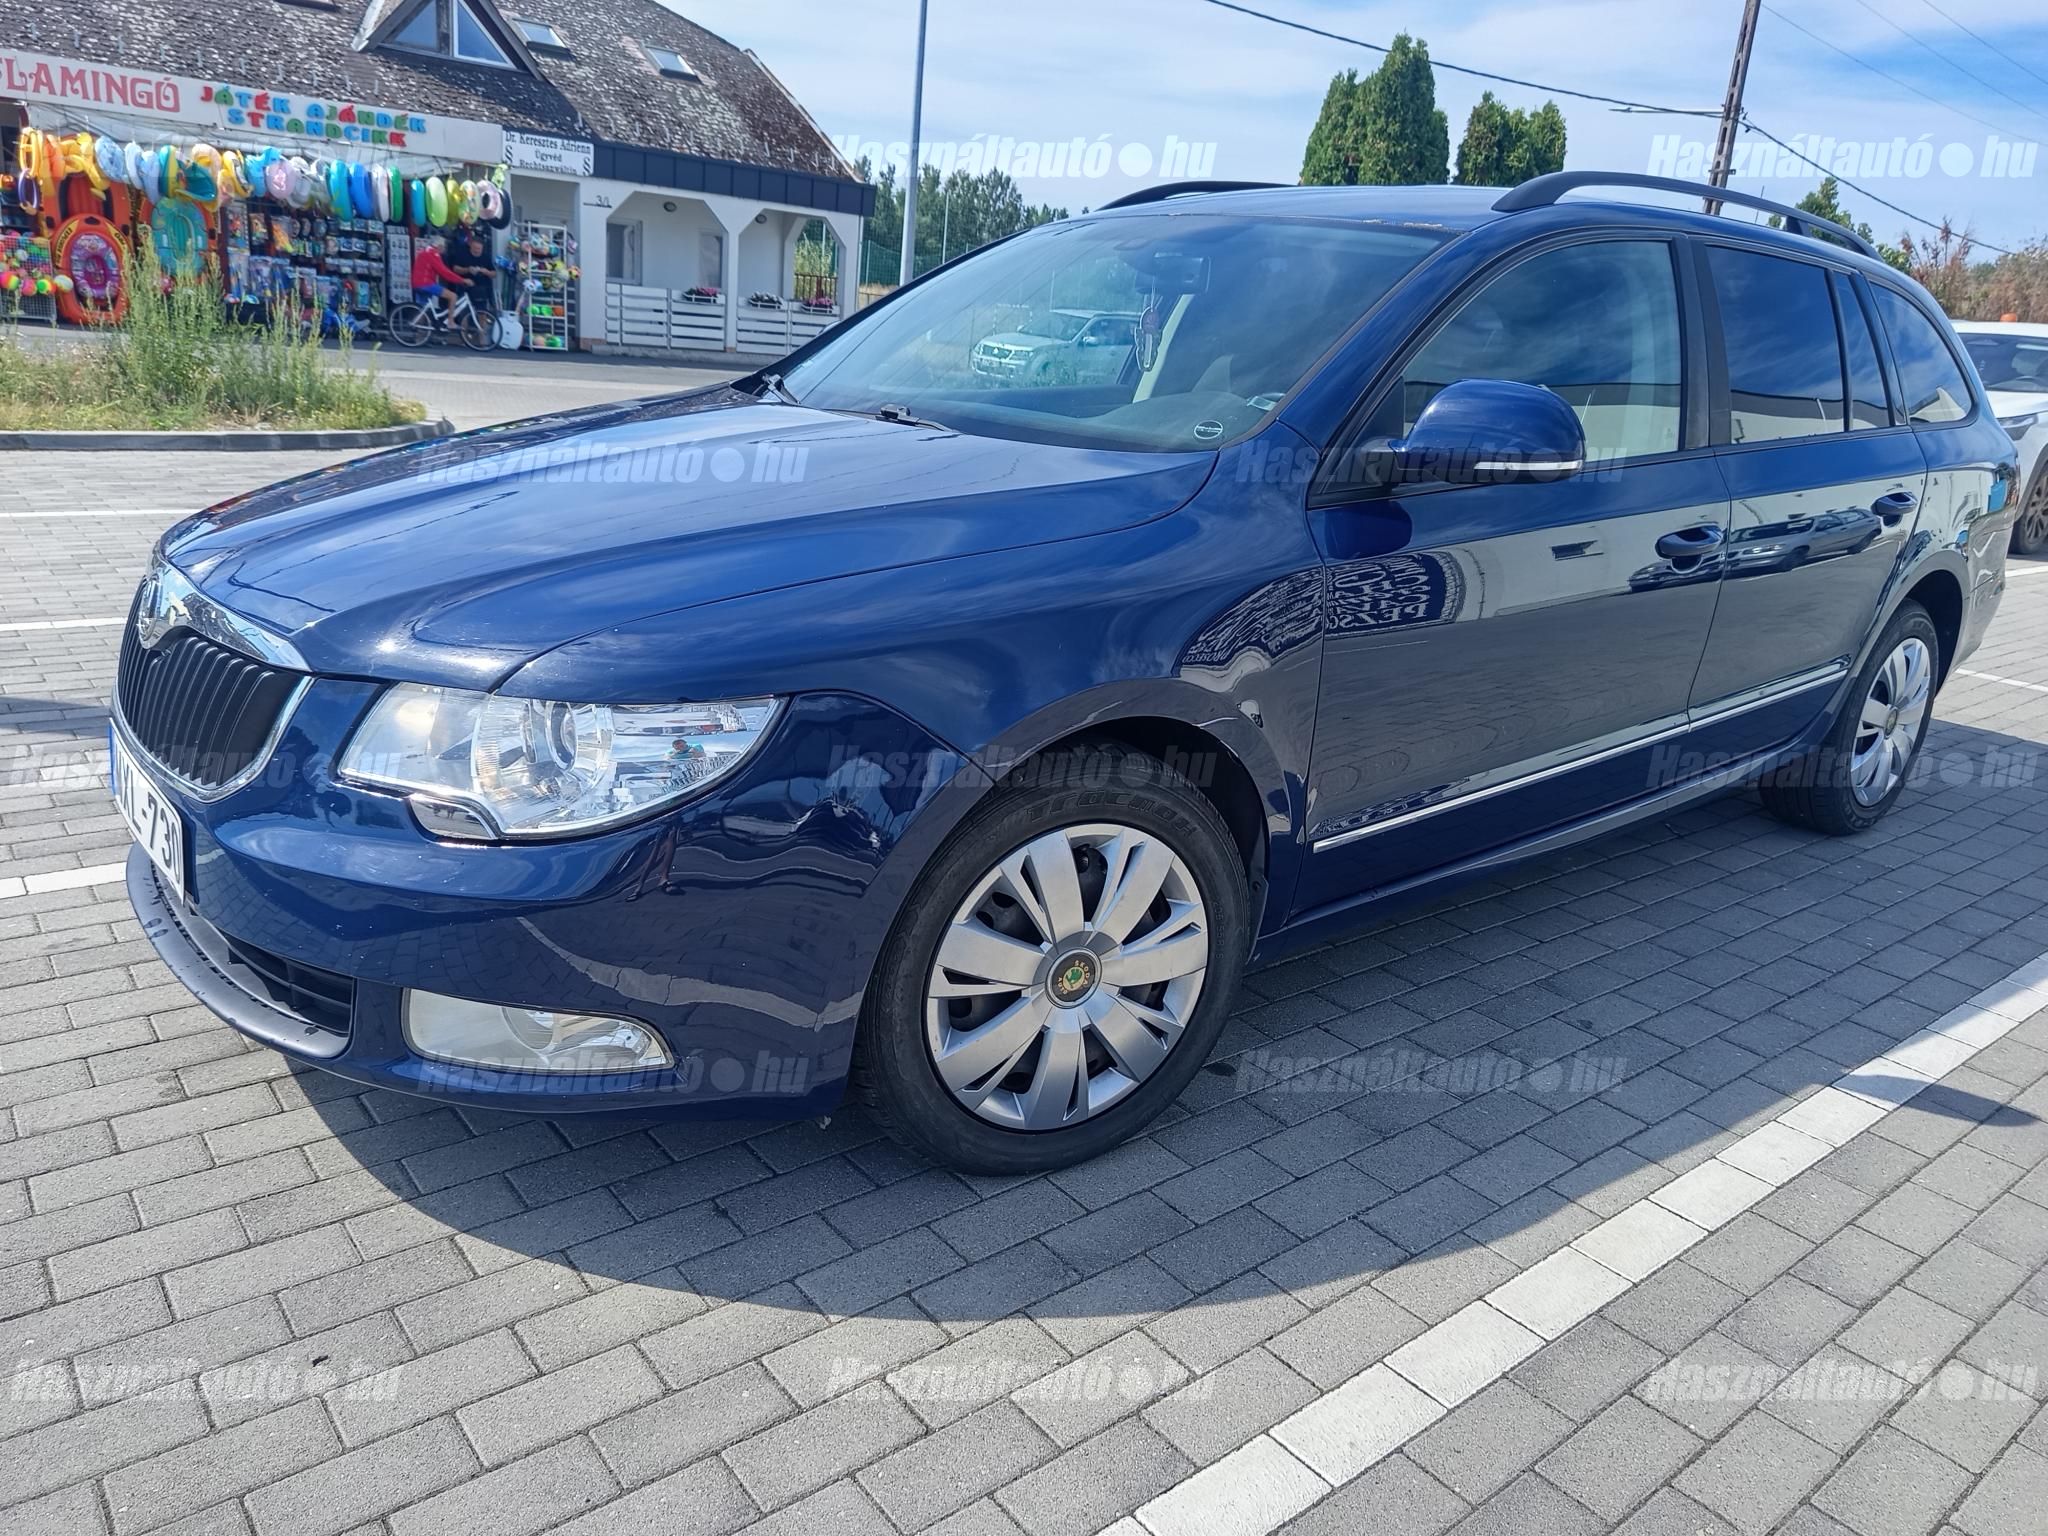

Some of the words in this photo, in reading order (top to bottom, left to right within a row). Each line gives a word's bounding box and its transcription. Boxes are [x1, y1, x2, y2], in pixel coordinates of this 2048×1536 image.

[0, 57, 181, 113] LAMINGÓ
[200, 85, 292, 115] JÁTÉK
[306, 103, 427, 134] AJÁNDÉK
[227, 108, 407, 147] STRANDCIKK
